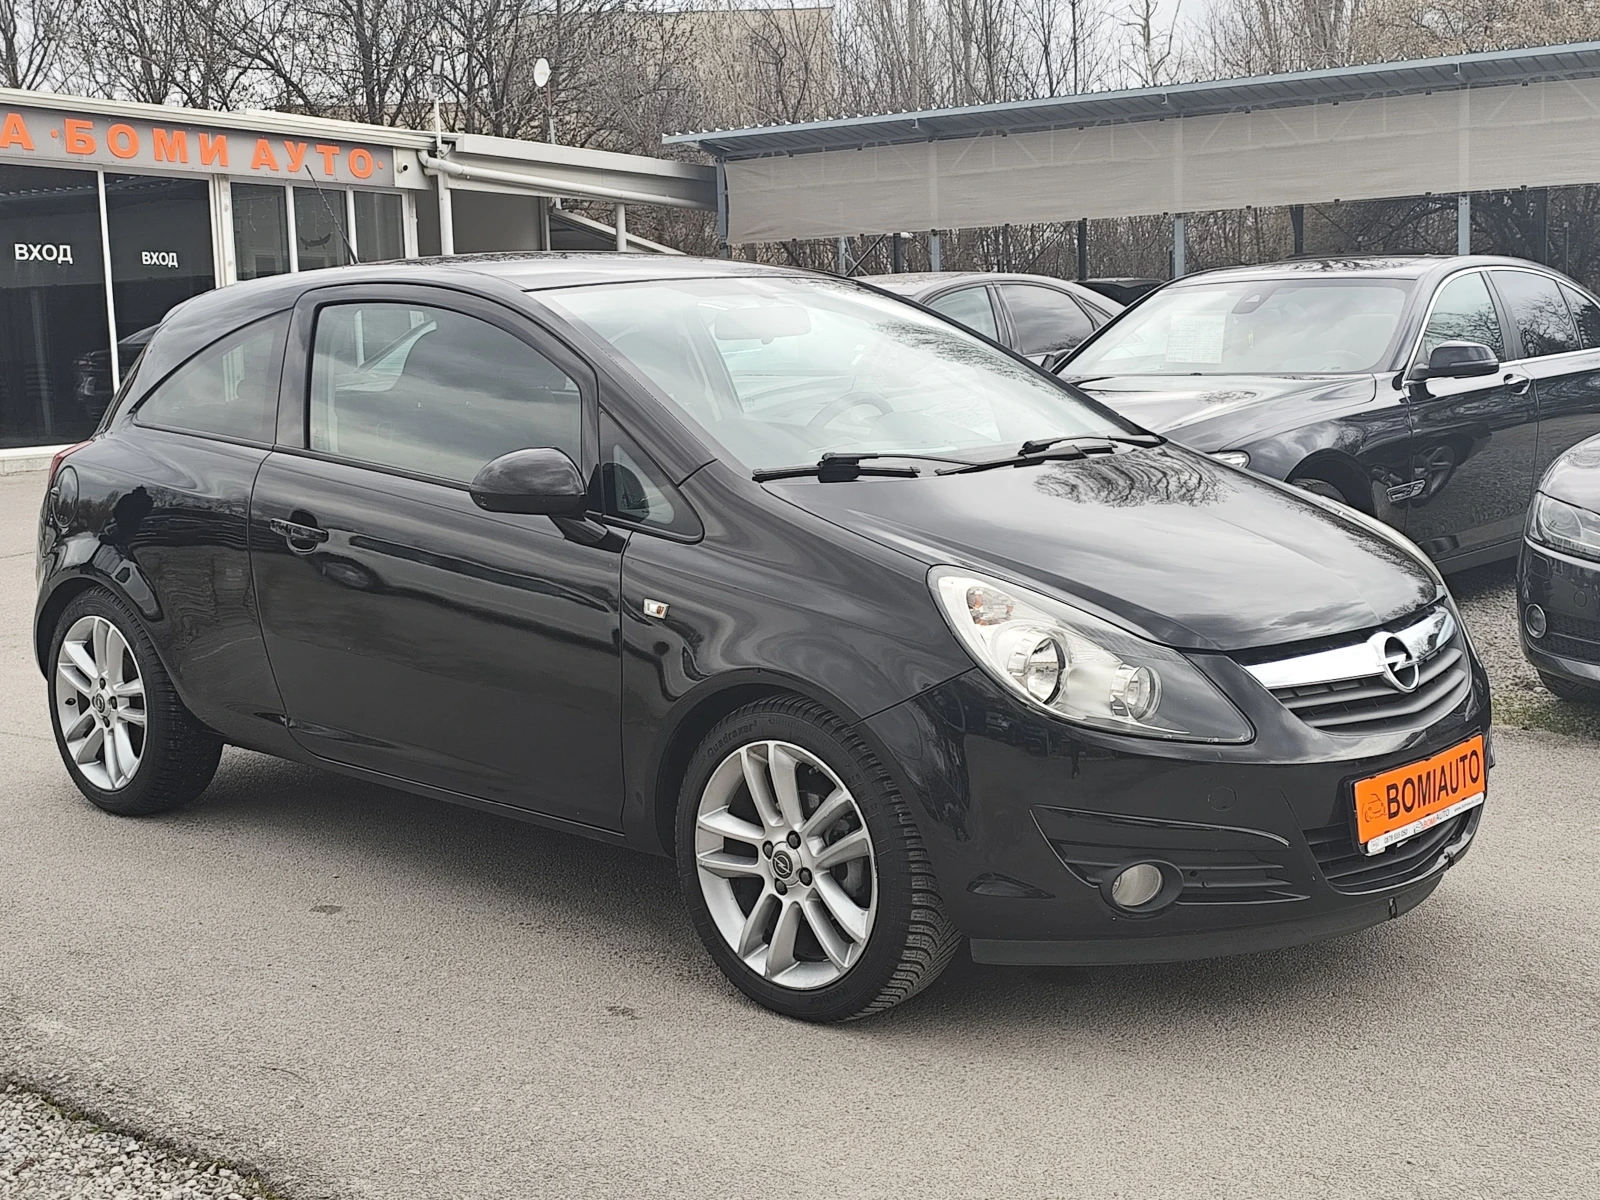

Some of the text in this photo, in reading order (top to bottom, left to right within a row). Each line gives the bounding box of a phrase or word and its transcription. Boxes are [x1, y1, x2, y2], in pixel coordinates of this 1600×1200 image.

[64, 117, 229, 168] БОМИ
[251, 137, 375, 180] АУТО
[14, 243, 74, 265] ВХОД
[141, 250, 180, 269] ВХОД
[1386, 749, 1480, 820] BOMIAUTO
